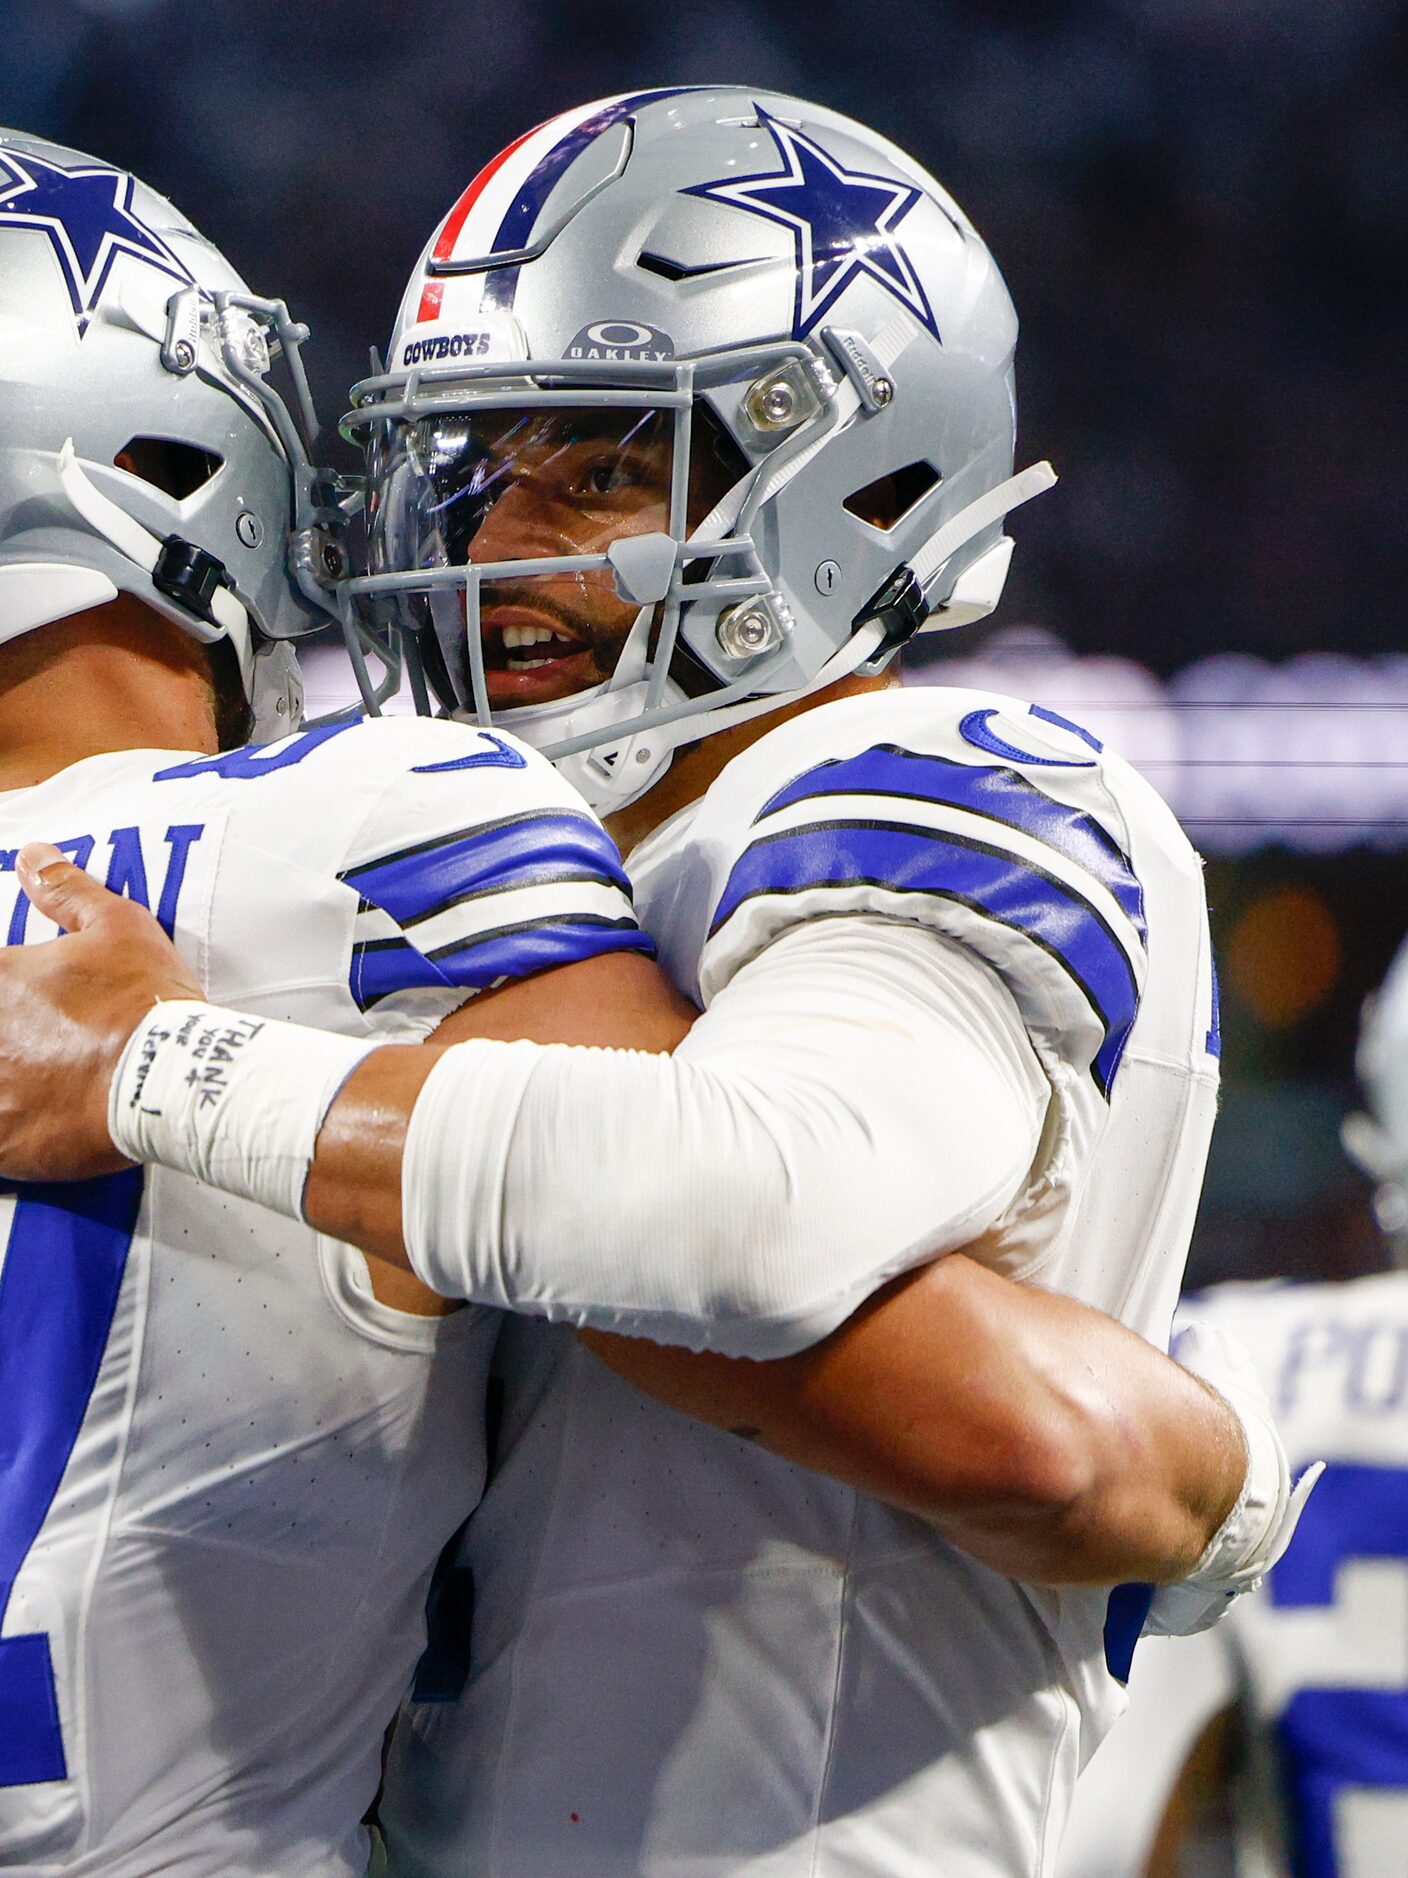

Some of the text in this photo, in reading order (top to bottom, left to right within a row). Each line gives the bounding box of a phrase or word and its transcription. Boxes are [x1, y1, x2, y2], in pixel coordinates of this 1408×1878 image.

[403, 333, 491, 366] COWBOYS
[570, 347, 667, 362] OAKLEY
[192, 1028, 220, 1059] YOU
[199, 1020, 266, 1110] THANK
